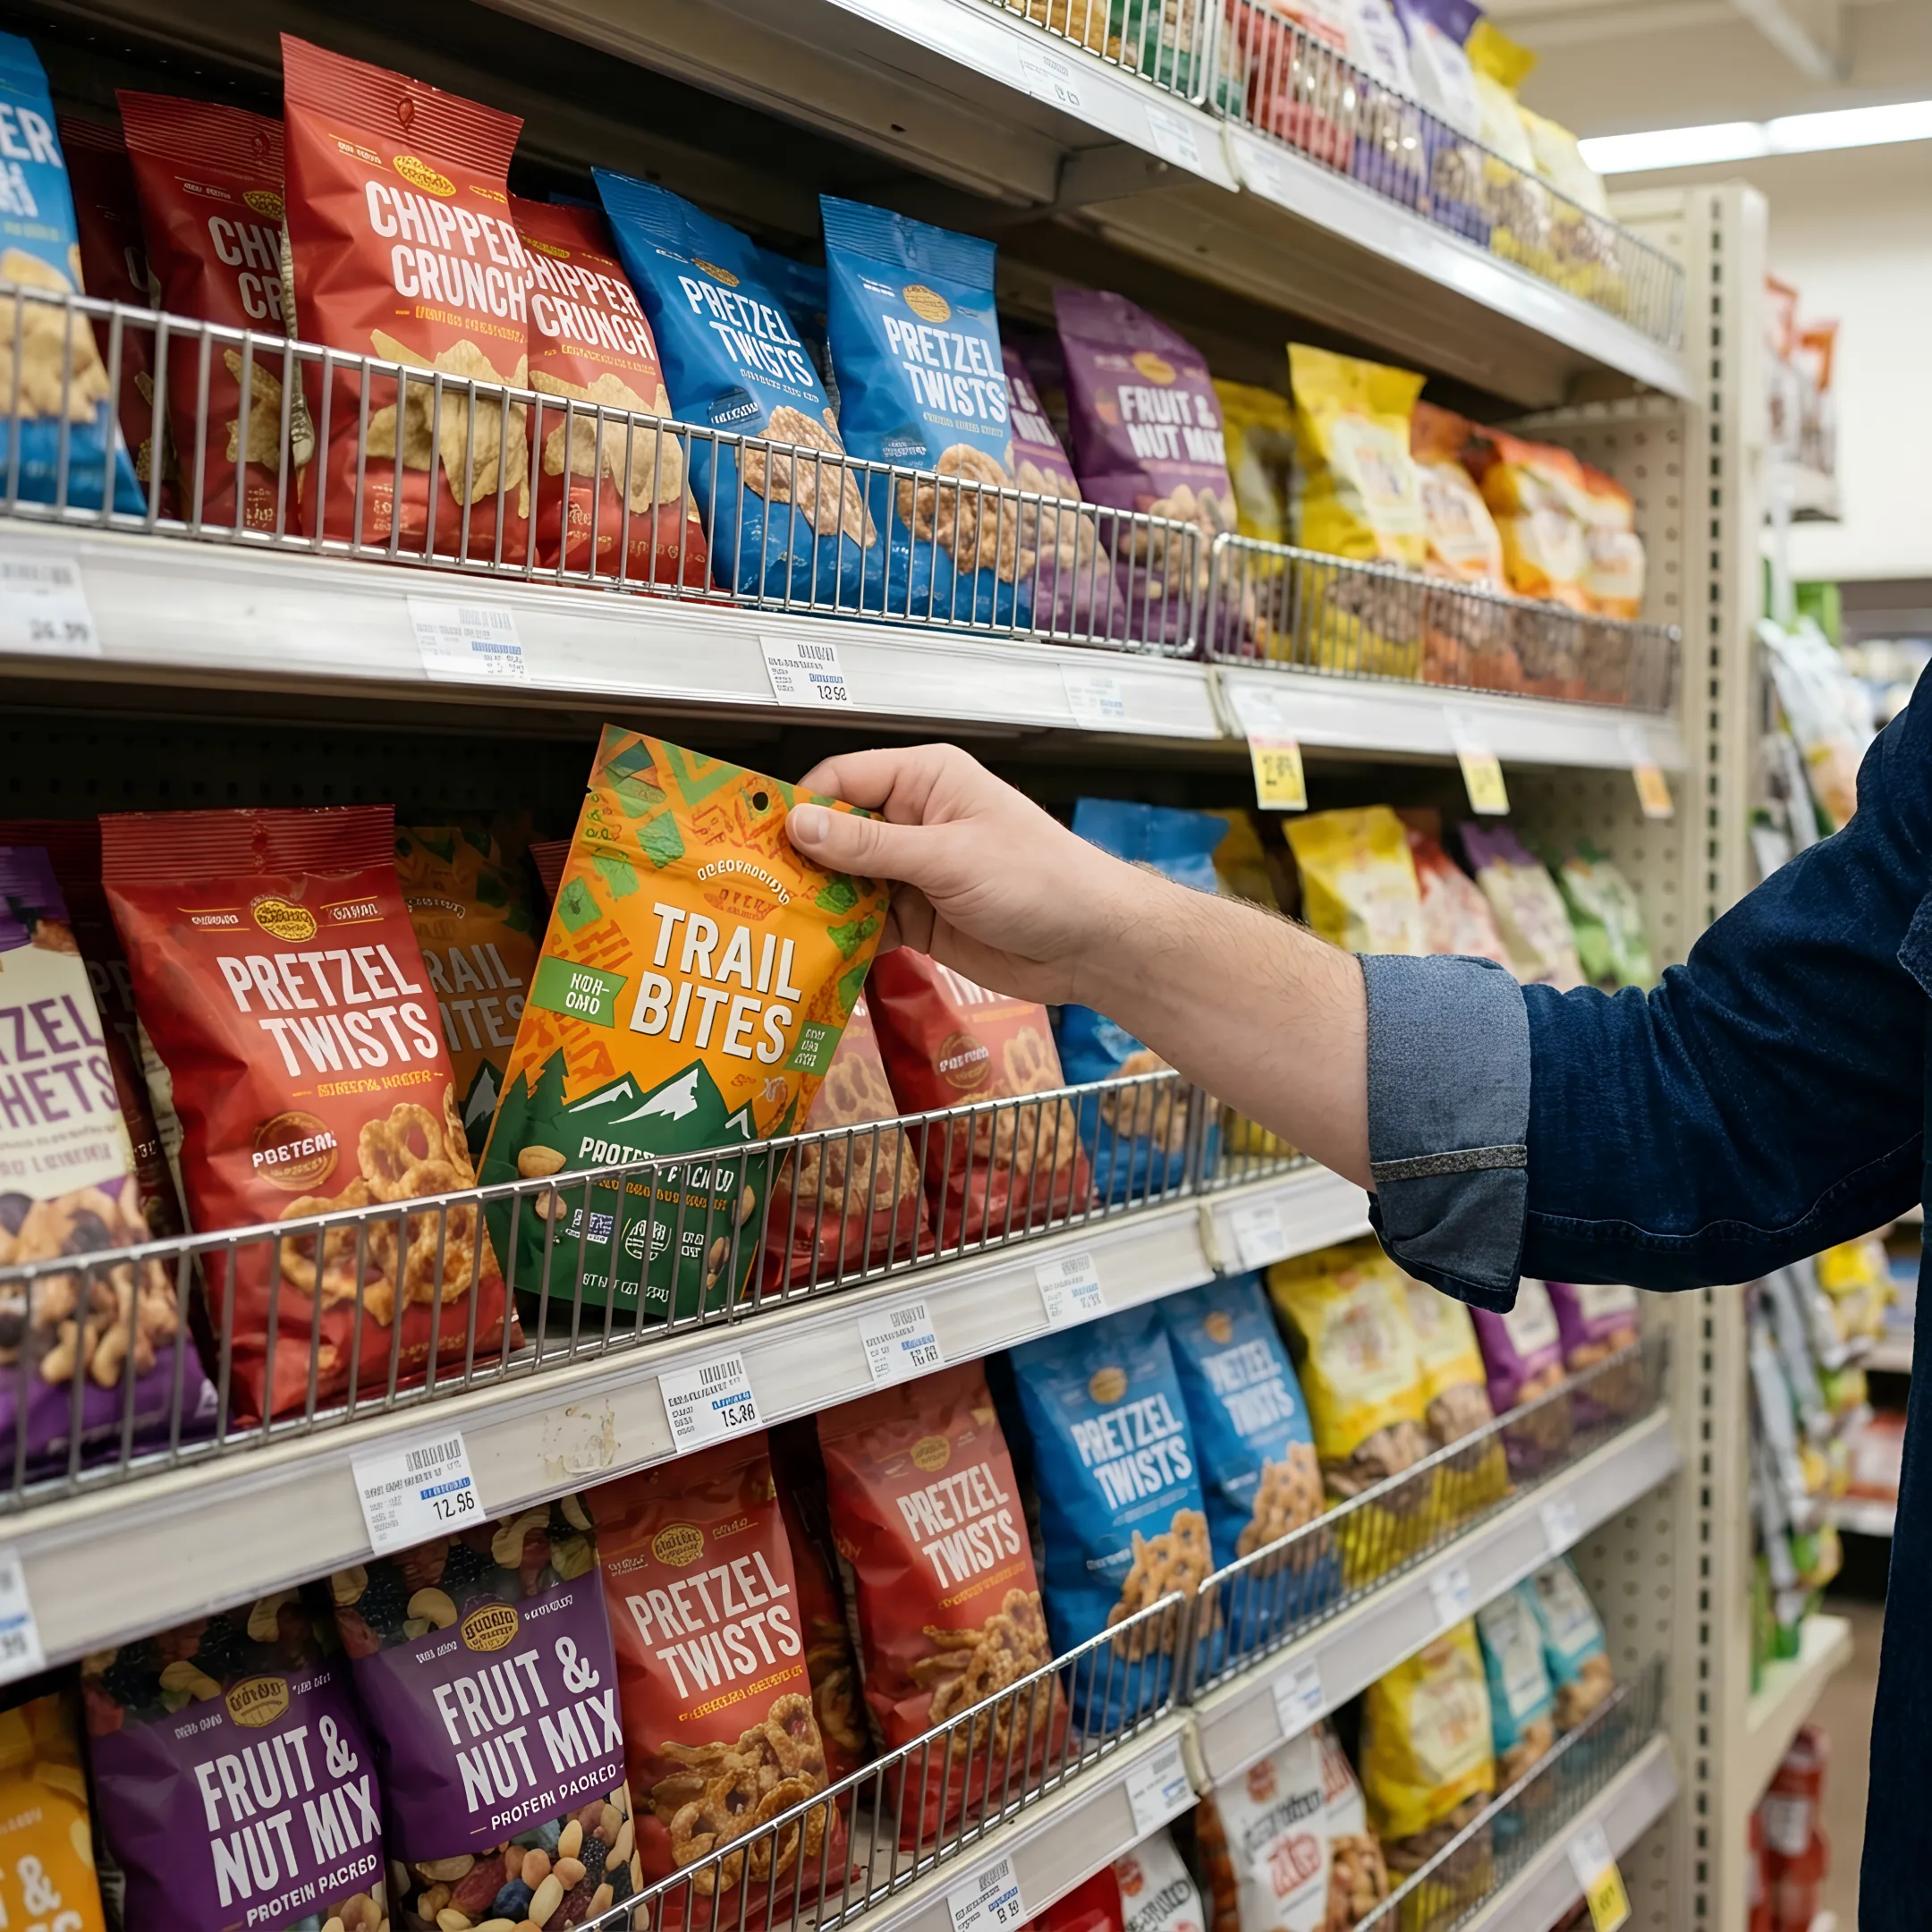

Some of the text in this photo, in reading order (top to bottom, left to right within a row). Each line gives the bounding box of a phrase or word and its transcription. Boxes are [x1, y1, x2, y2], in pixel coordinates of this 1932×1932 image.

[365, 181, 528, 269] CHIPPER
[391, 245, 528, 324] CRUNCH
[678, 275, 801, 348] PRETZEL
[531, 293, 656, 360] CRUNCH
[709, 321, 814, 388] TWISTS
[882, 315, 1005, 382] PRETZEL
[902, 361, 1007, 423] TWISTS
[1118, 385, 1191, 426] FRUIT
[1126, 423, 1181, 460] NUT
[216, 944, 422, 1013] PRETZEL
[422, 944, 523, 994] RAIL
[652, 902, 802, 1001] TRAIL
[258, 1002, 439, 1077] TWISTS
[629, 970, 792, 1064] BITES
[1071, 1392, 1184, 1468] PRETZEL
[896, 1462, 1009, 1542] PRETZEL
[1093, 1436, 1193, 1511] TWISTS
[922, 1509, 1021, 1589] TWISTS
[625, 1550, 791, 1647] PRETZEL
[656, 1604, 801, 1699] TWISTS
[432, 1649, 540, 1745] FRUIT
[554, 1635, 599, 1693] &
[194, 1715, 358, 1833] FRUIT &
[455, 1724, 538, 1814] NUT
[540, 1689, 623, 1773] MIX
[210, 1775, 382, 1908] NUT MIX
[246, 1882, 316, 1928] PROTEIN
